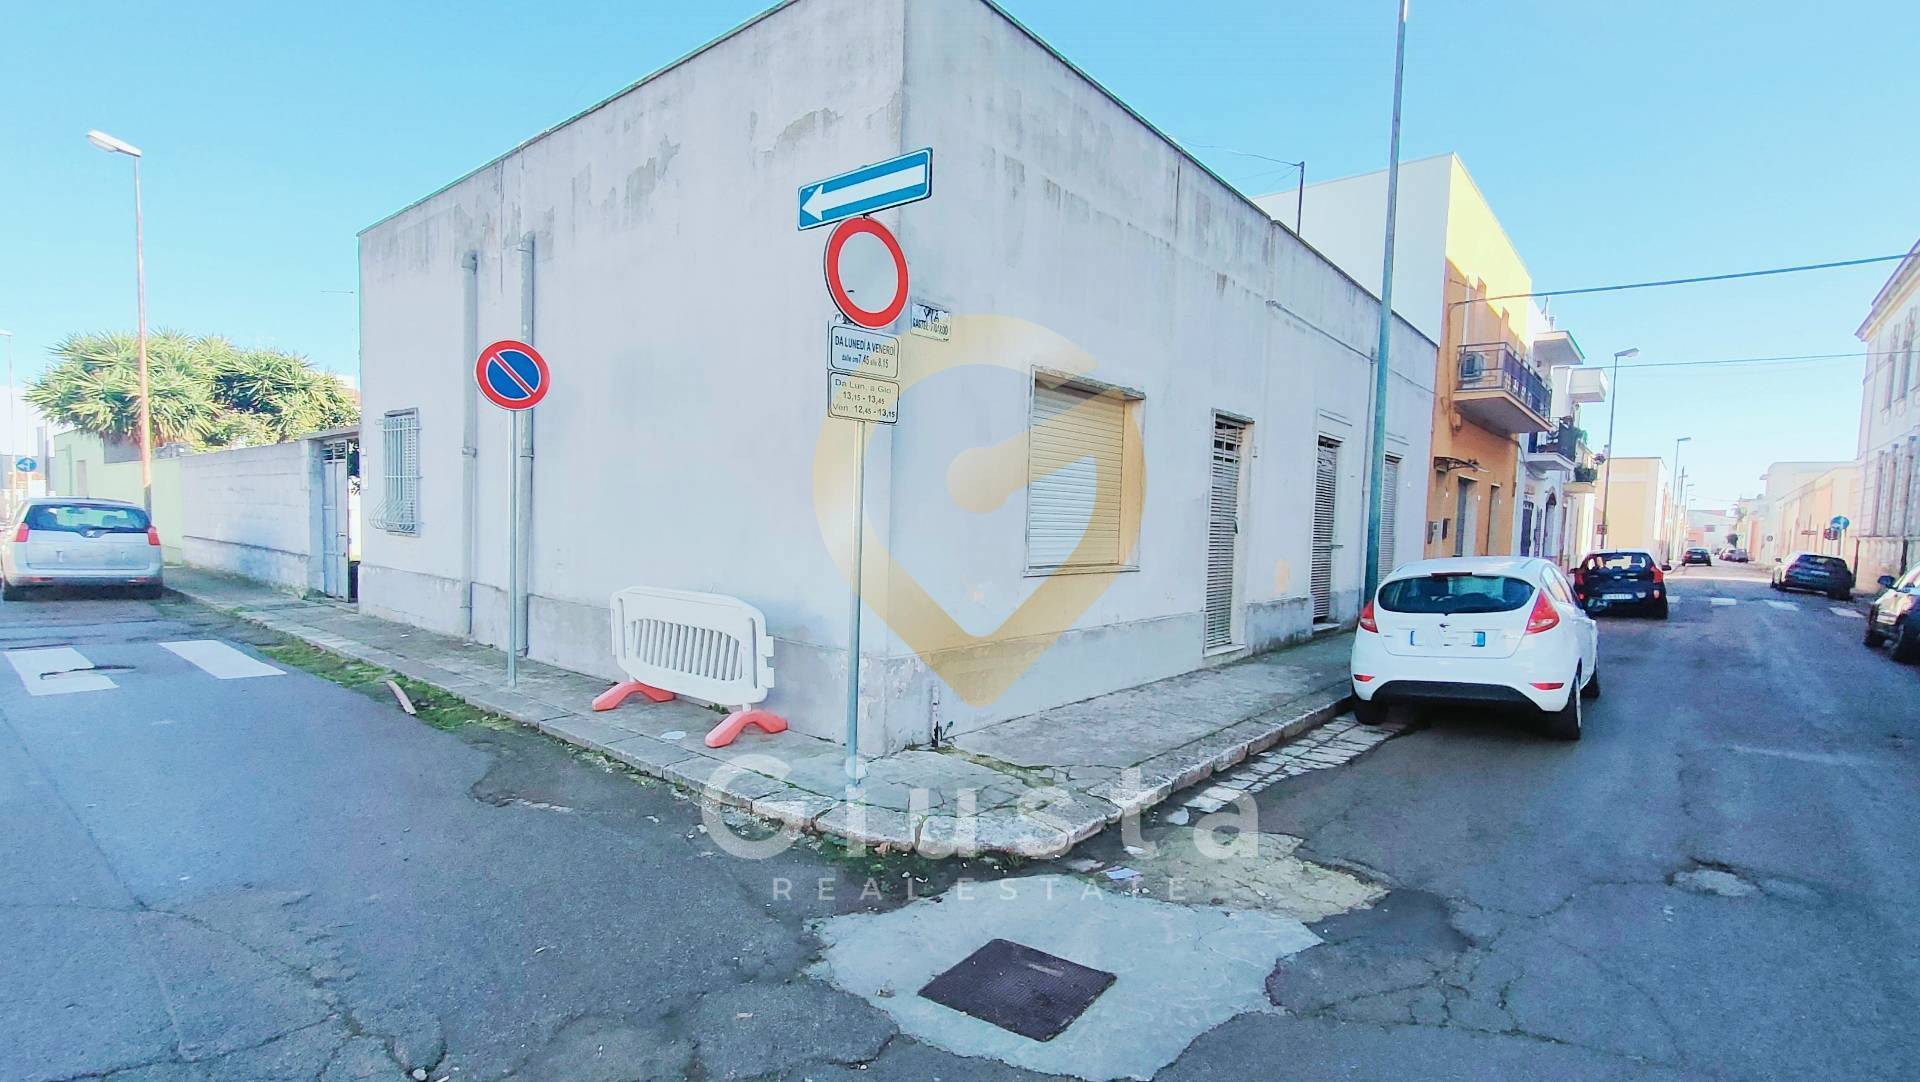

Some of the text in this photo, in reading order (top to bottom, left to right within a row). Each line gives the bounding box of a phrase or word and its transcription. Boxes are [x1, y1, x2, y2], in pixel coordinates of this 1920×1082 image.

[835, 335, 844, 346] DA
[866, 341, 871, 352] A
[835, 379, 847, 387] Da
[843, 391, 861, 402] 13,15
